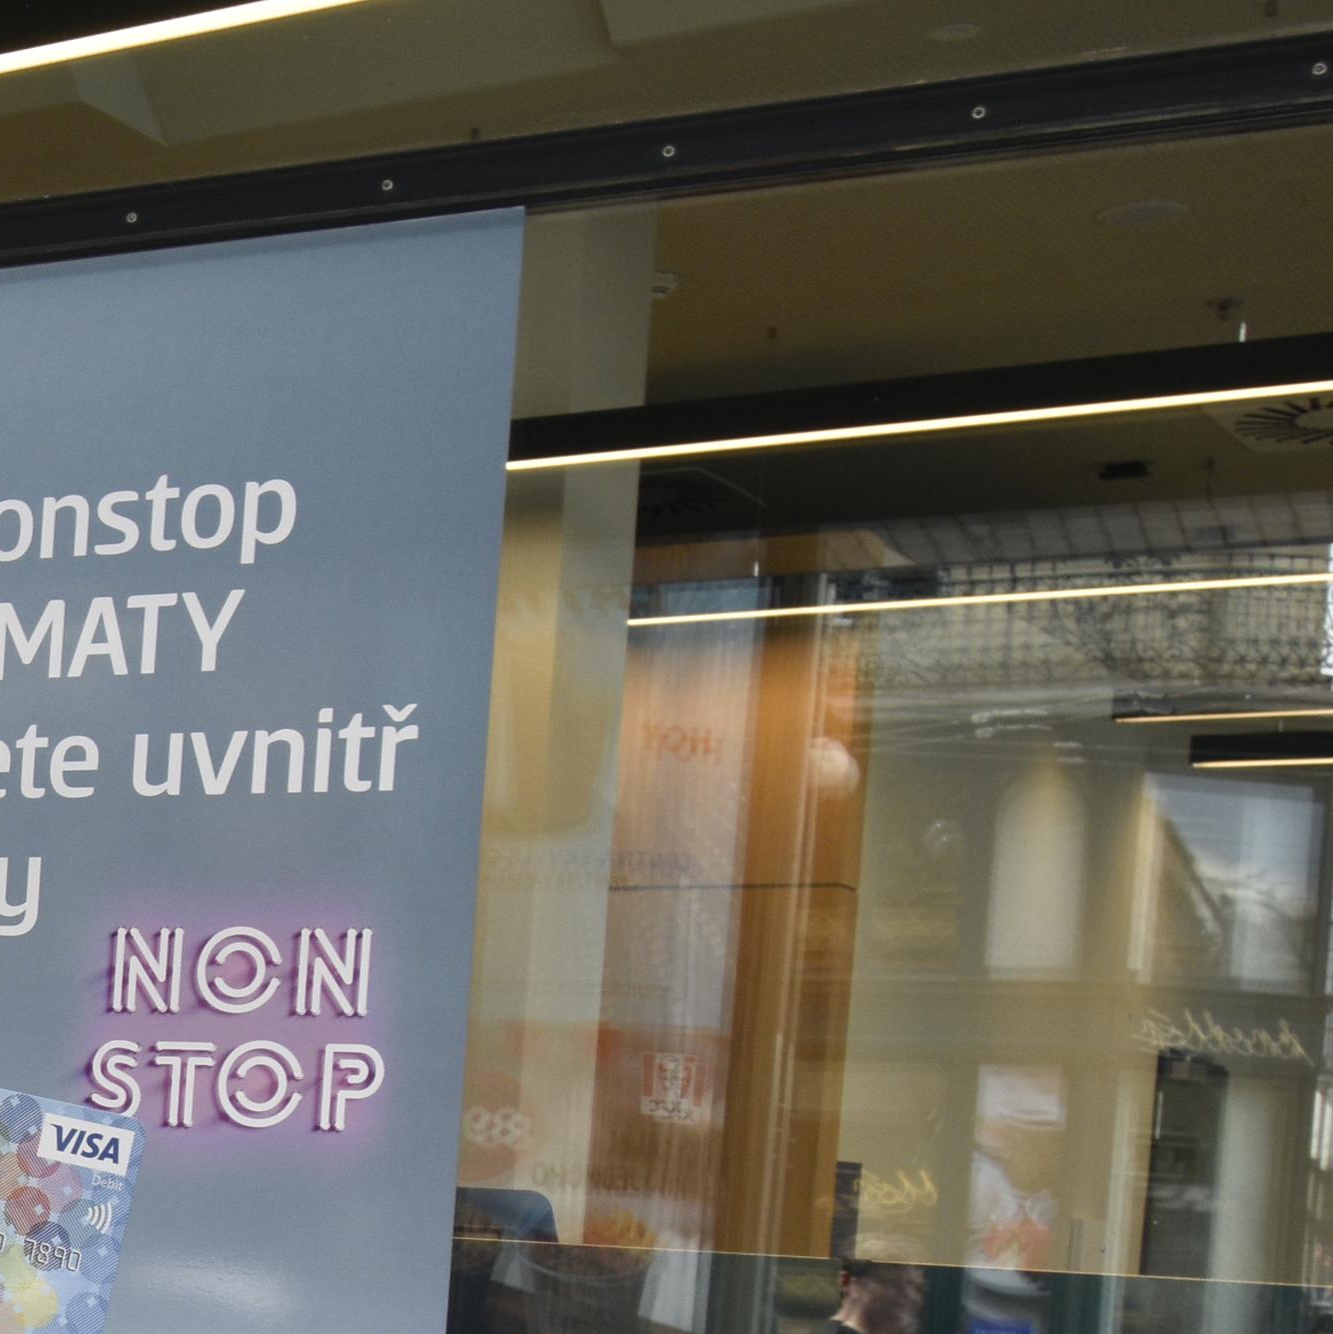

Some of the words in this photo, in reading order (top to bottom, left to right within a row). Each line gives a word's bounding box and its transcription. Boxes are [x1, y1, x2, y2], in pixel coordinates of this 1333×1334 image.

[132, 703, 420, 797] uvnitř
[108, 926, 373, 1018] NON
[86, 1039, 386, 1132] STOP
[50, 1122, 122, 1165] VISA
[90, 1173, 125, 1193] Debit
[23, 1237, 82, 1272] 7890
